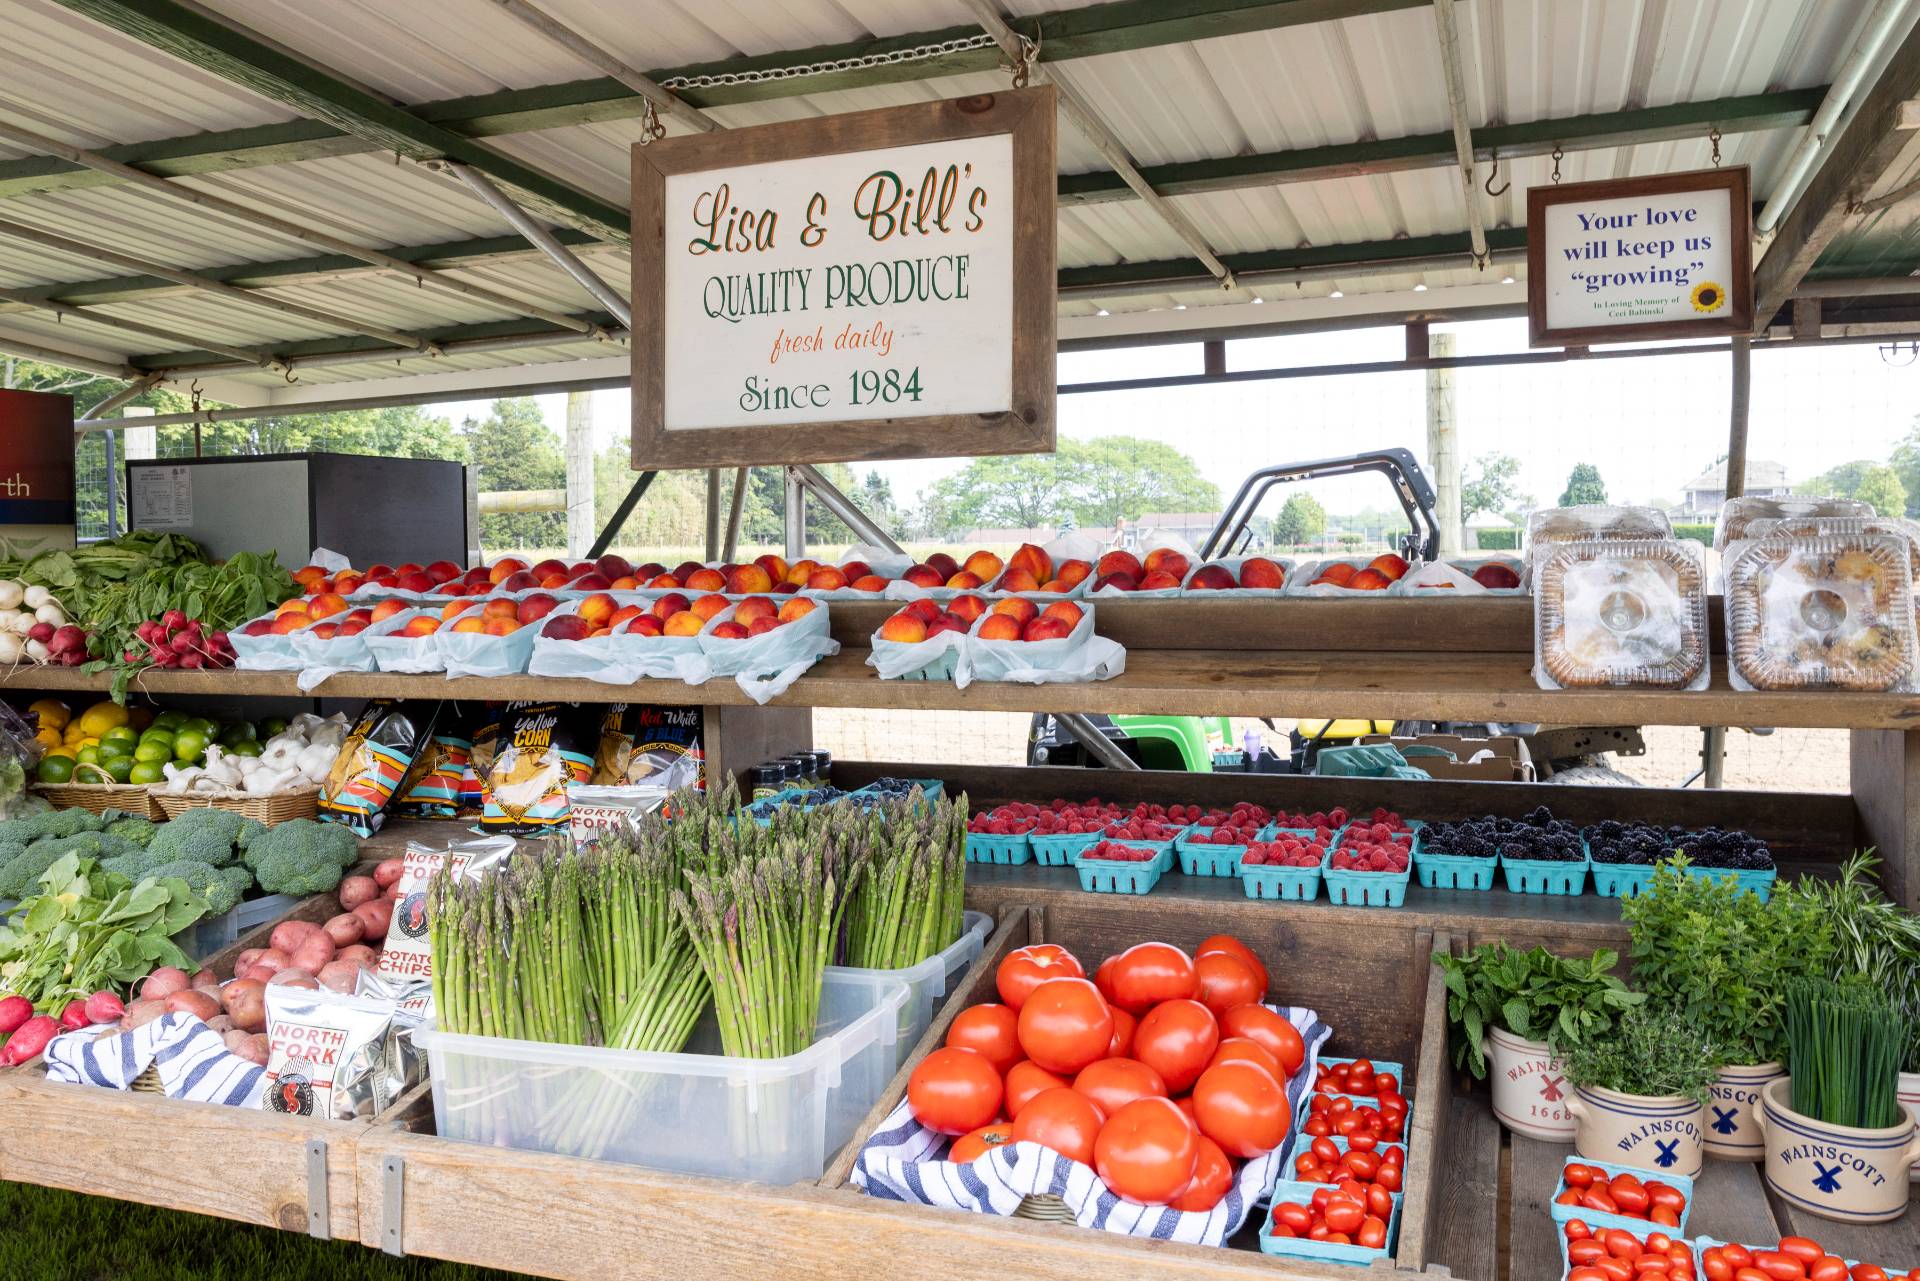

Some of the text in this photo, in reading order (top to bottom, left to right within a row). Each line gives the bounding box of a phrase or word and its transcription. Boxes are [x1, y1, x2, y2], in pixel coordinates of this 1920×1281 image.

[688, 162, 988, 256] Lisa & Bill's
[1577, 207, 1697, 231] Your love
[1563, 235, 1712, 261] will keep us
[703, 254, 970, 324] QUALITY PRODUCE
[1605, 300, 1632, 308] Loving
[1635, 298, 1668, 306] Memory
[1671, 296, 1681, 304] of
[770, 321, 895, 364] fresh daily
[739, 366, 924, 412] Since 1984
[514, 713, 558, 734] Yellow
[514, 728, 551, 748] CORN
[572, 806, 628, 818] NORTH
[274, 1024, 344, 1046] NORTH
[271, 1039, 337, 1065] FORK
[1780, 1144, 1886, 1188] WAINSCOTT
